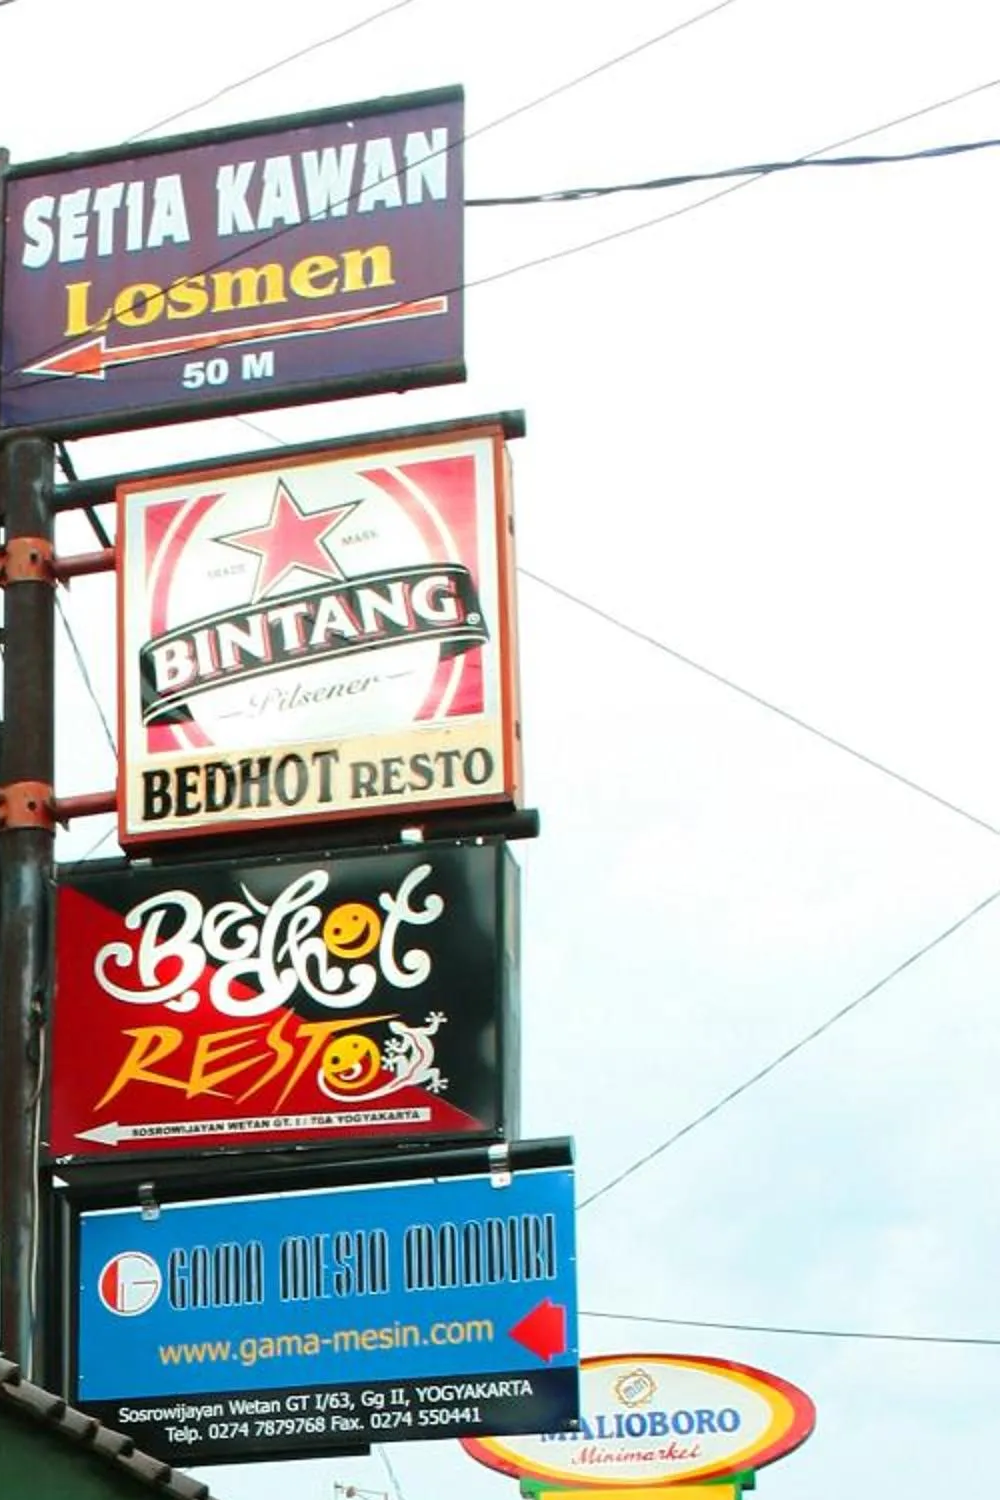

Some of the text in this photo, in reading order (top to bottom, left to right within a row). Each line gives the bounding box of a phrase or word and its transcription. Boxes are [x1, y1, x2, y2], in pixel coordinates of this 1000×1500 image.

[21, 127, 448, 269] SETIA KAWAN
[64, 242, 395, 337] Losmen
[182, 351, 274, 390] 50 M
[153, 574, 464, 696] BINTANG
[246, 676, 380, 717] Pilsener
[141, 746, 495, 821] BEDHOT RESTO
[93, 1007, 399, 1112] RESTO
[227, 1117, 270, 1133] WETAN
[336, 1108, 421, 1124] YOGYAKARTA
[168, 1239, 265, 1311] GAMA
[279, 1228, 390, 1303] MESIN
[404, 1213, 556, 1293] MANDIRI
[158, 1317, 494, 1367] www.gama-mesin.com
[118, 1379, 534, 1423] Sosrowijayan Wetan GT I/63, Gg II, YOGYAKARTA
[165, 1407, 483, 1445] Telp. 0274 7879768 Fax. 0274 550441
[571, 1441, 701, 1466] Minimarket
